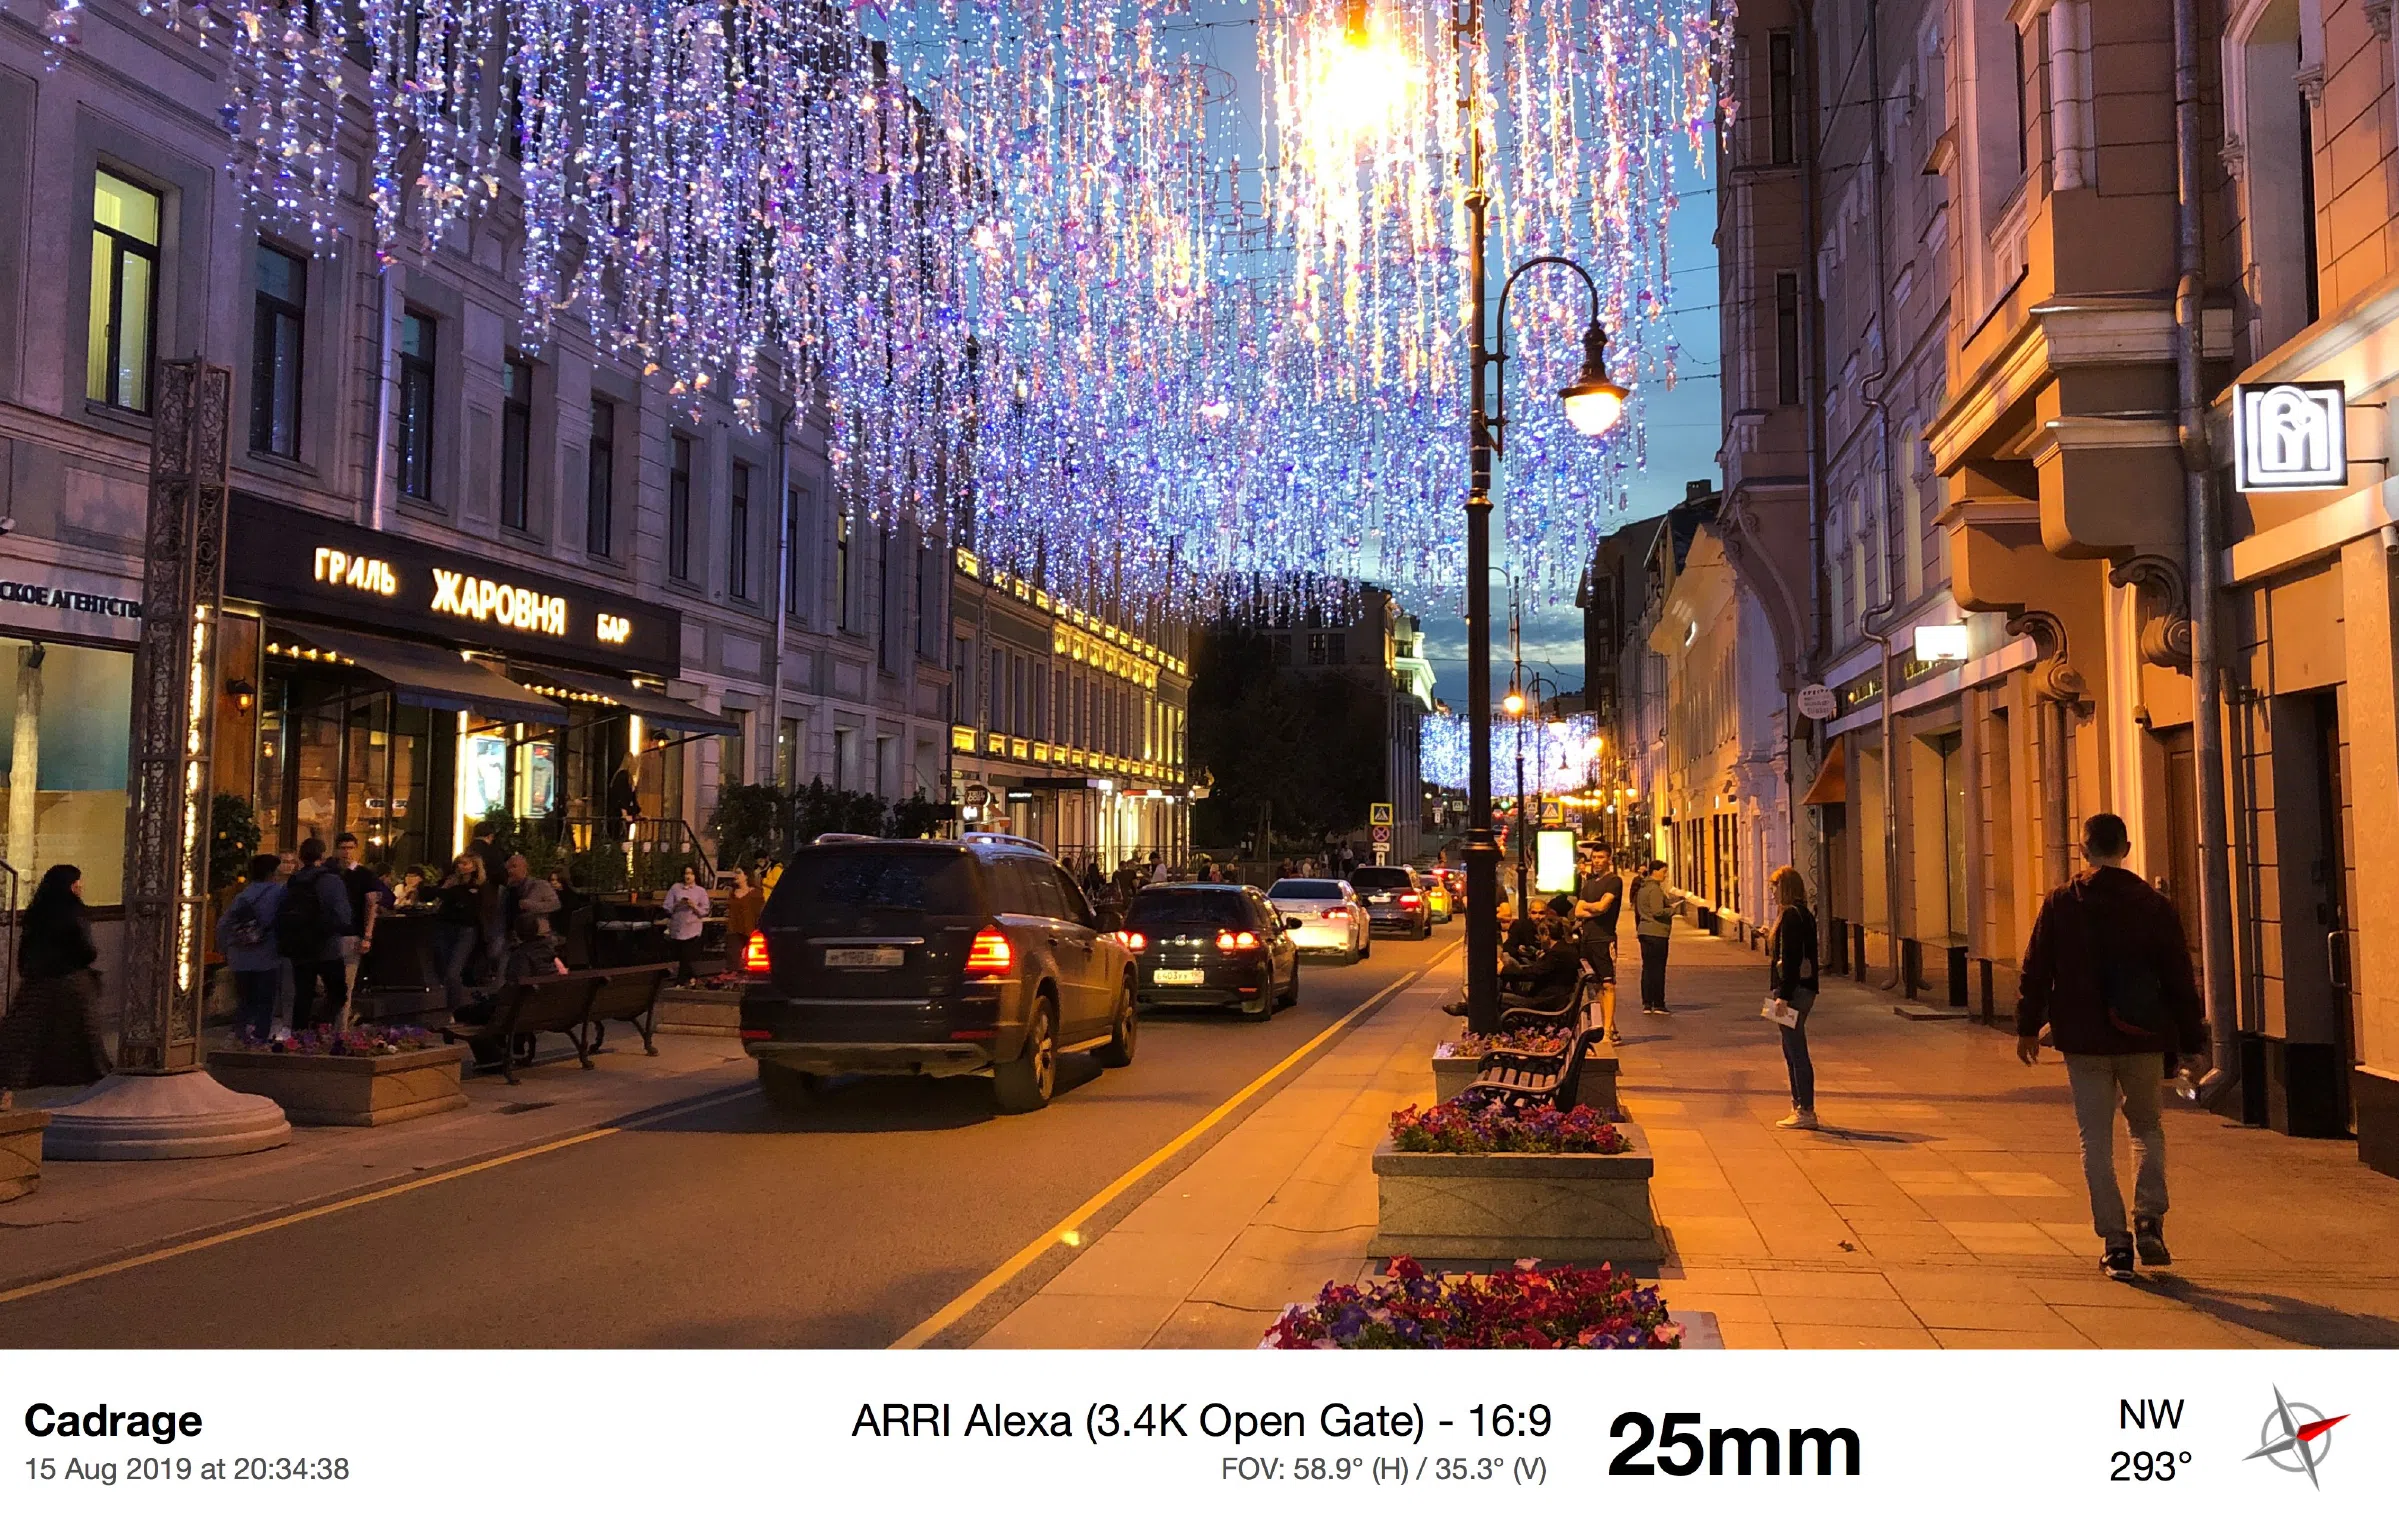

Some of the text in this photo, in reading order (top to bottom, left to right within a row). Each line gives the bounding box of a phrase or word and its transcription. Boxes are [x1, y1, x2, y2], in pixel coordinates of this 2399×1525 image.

[314, 547, 631, 644] ГРИЛЬ ЖАРОВНЯ БАР
